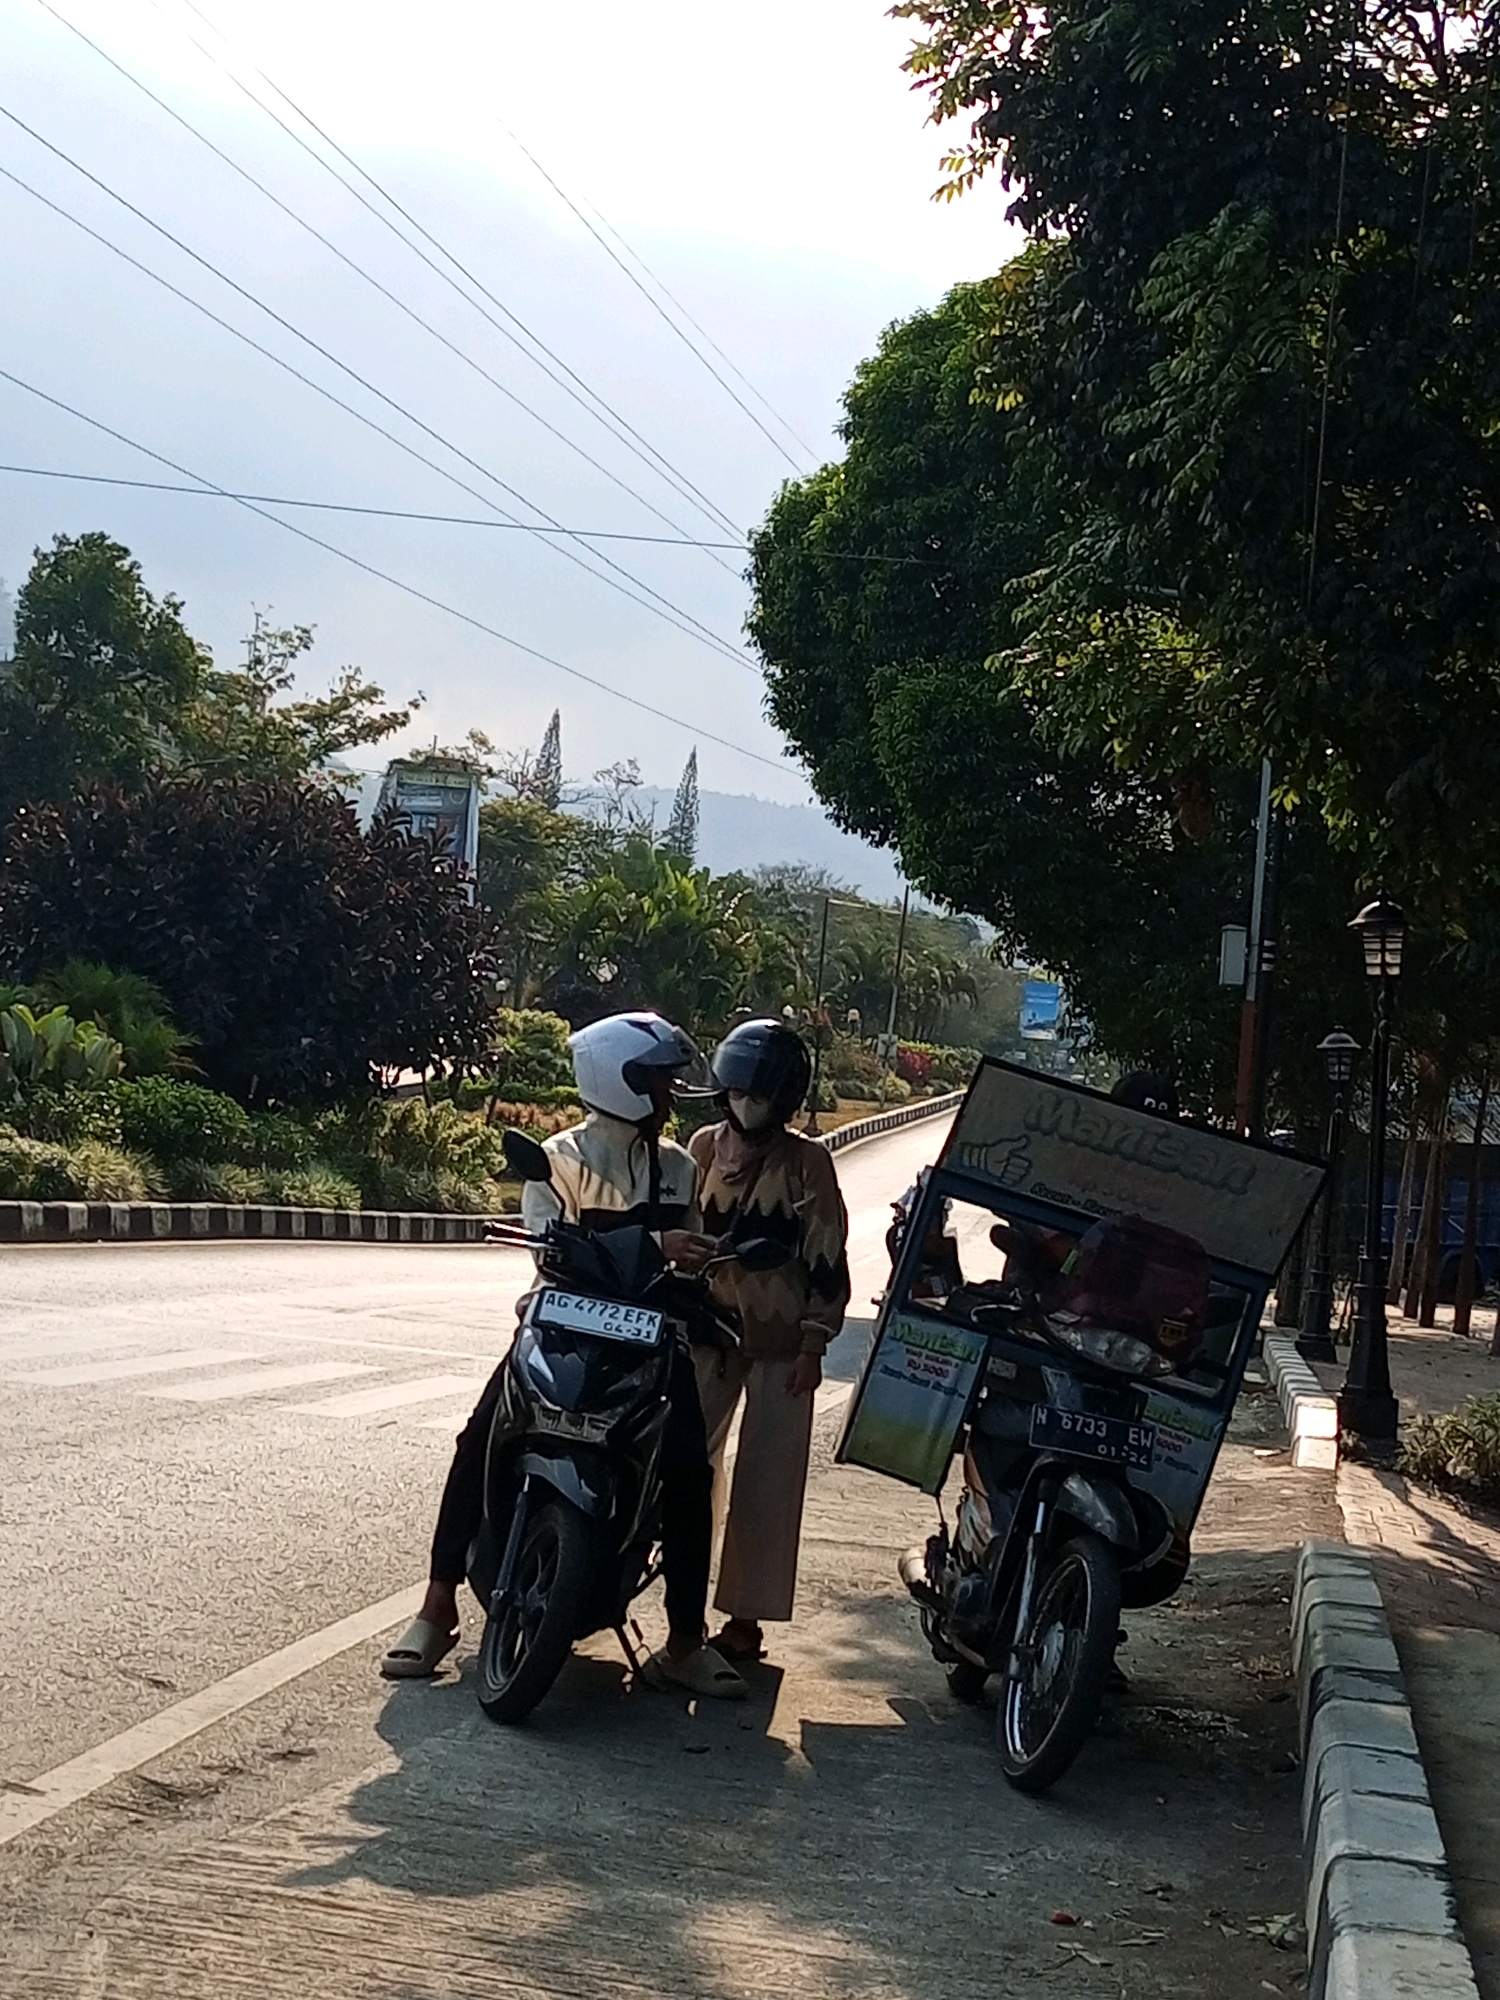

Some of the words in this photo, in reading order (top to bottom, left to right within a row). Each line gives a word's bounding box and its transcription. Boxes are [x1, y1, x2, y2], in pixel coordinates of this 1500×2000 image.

[1024, 1092, 1257, 1195] Manisan
[545, 1293, 568, 1308] AG
[574, 1298, 621, 1320] 4772
[623, 1310, 659, 1328] EFK
[889, 1322, 980, 1365] Manisan
[1036, 1407, 1047, 1425] N
[1061, 1413, 1107, 1438] 6733
[1128, 1427, 1152, 1448] EW
